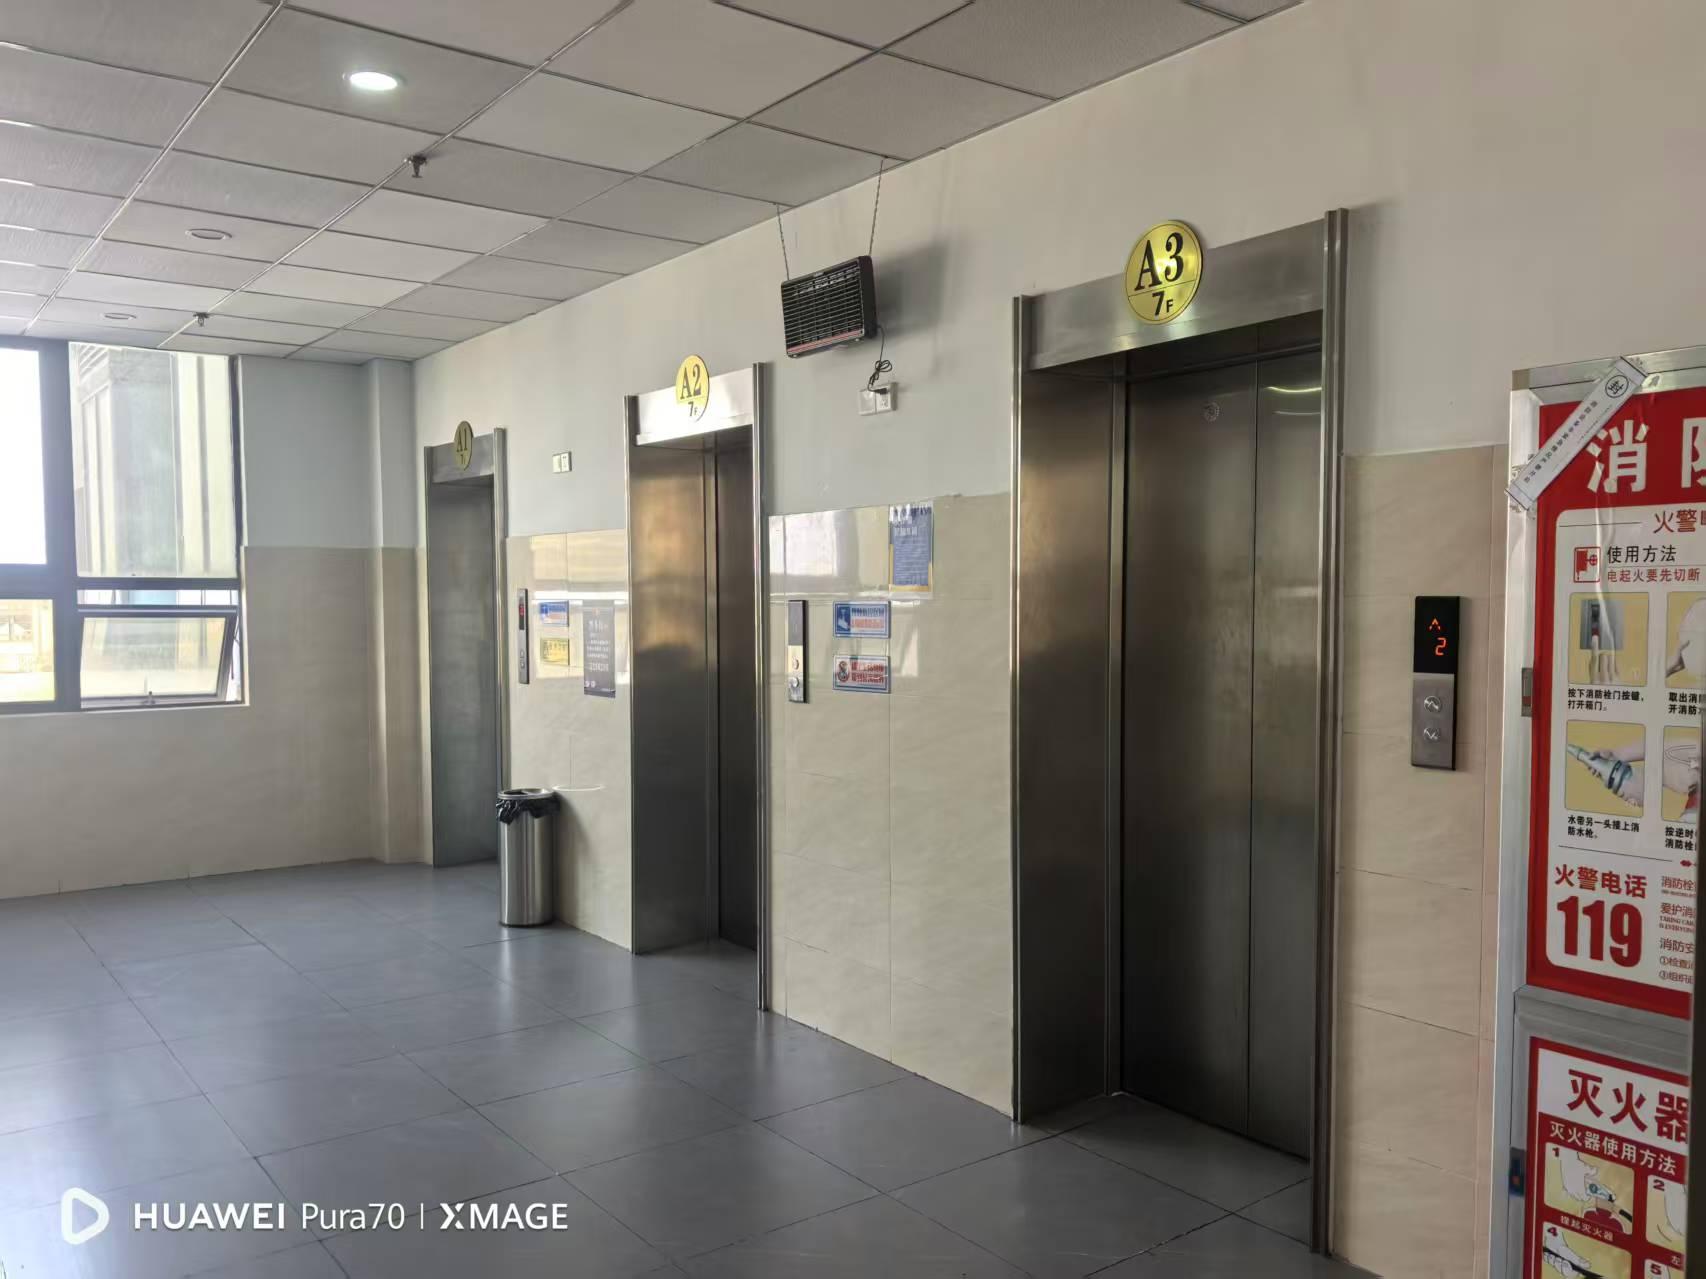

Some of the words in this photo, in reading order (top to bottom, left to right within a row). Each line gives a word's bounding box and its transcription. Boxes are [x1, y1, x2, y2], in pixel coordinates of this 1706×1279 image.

[1134, 231, 1184, 291] A3
[1151, 290, 1173, 316] 7F
[680, 363, 701, 400] A2
[456, 427, 468, 452] A1
[1607, 545, 1677, 564] 使用方法
[1435, 637, 1447, 656] 2
[1665, 826, 1698, 840] 按逆时
[1665, 838, 1698, 852] 消防栓
[1555, 863, 1647, 899] 火警电话
[1661, 876, 1696, 891] 消防栓
[1660, 903, 1696, 919] 爱护消
[1557, 896, 1642, 968] 119
[1567, 1068, 1689, 1145] 灭火器
[1550, 1120, 1676, 1176] 灭火器使用方法
[1552, 1147, 1560, 1158] 1
[1653, 1179, 1665, 1191] 2
[1547, 1227, 1558, 1237] 4
[1651, 1264, 1662, 1275] 5
